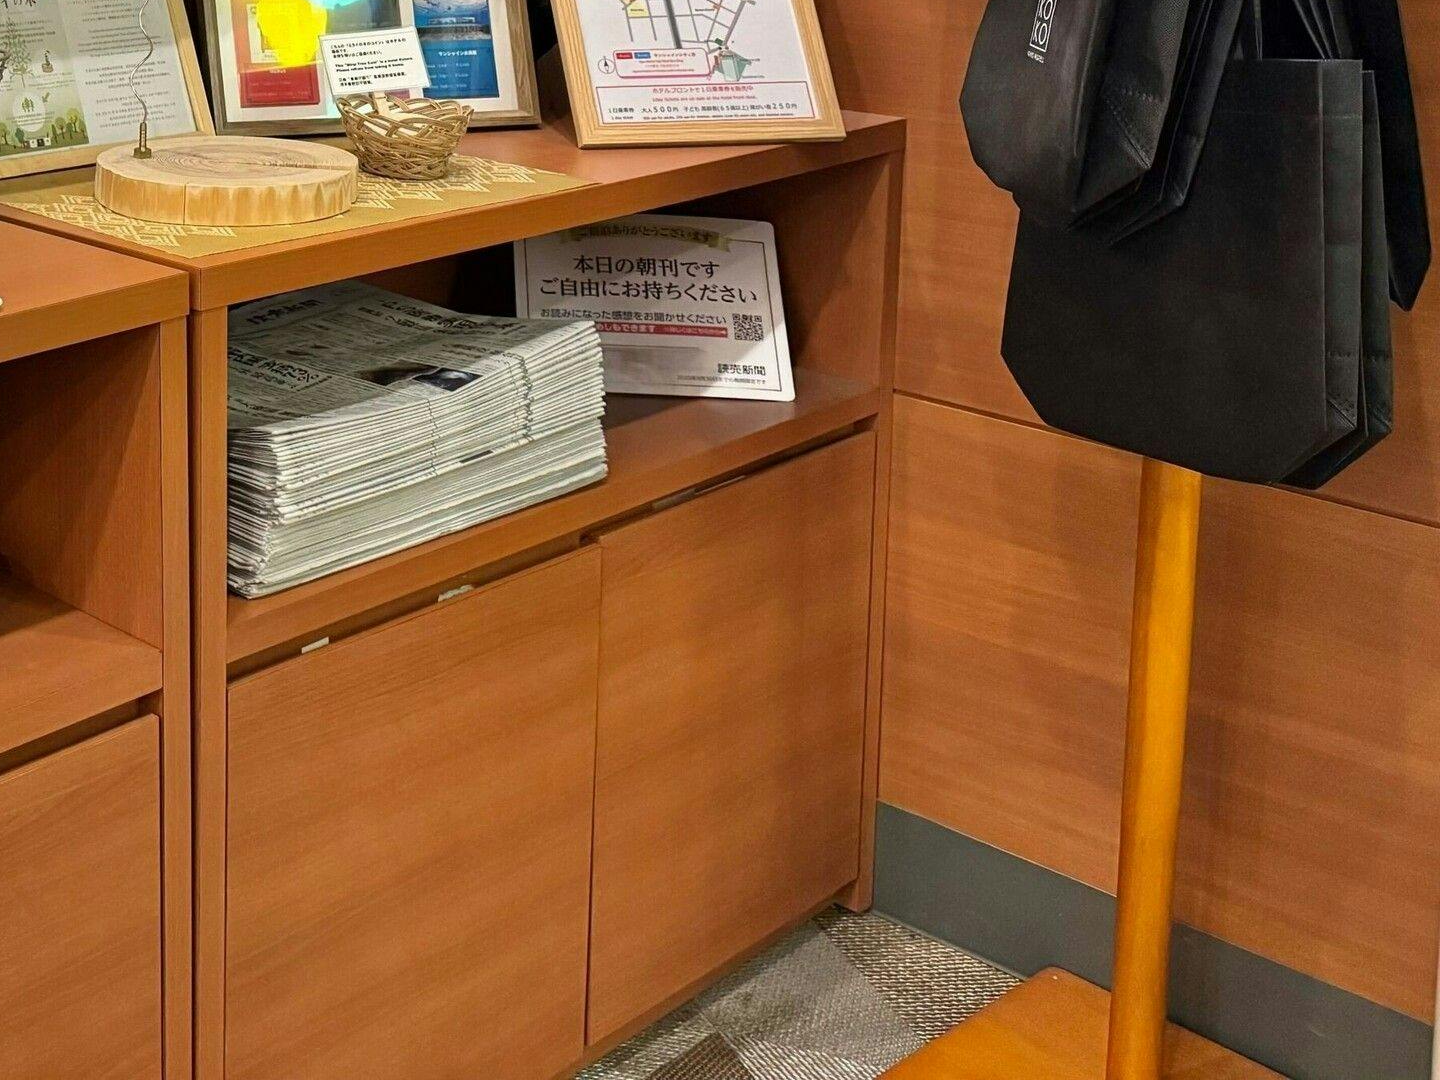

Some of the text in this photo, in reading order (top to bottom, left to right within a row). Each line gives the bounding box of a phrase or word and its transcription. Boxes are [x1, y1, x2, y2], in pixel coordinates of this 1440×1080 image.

[574, 254, 720, 278] 本日の朝刊です
[540, 277, 758, 304] ご自由にお持ちください
